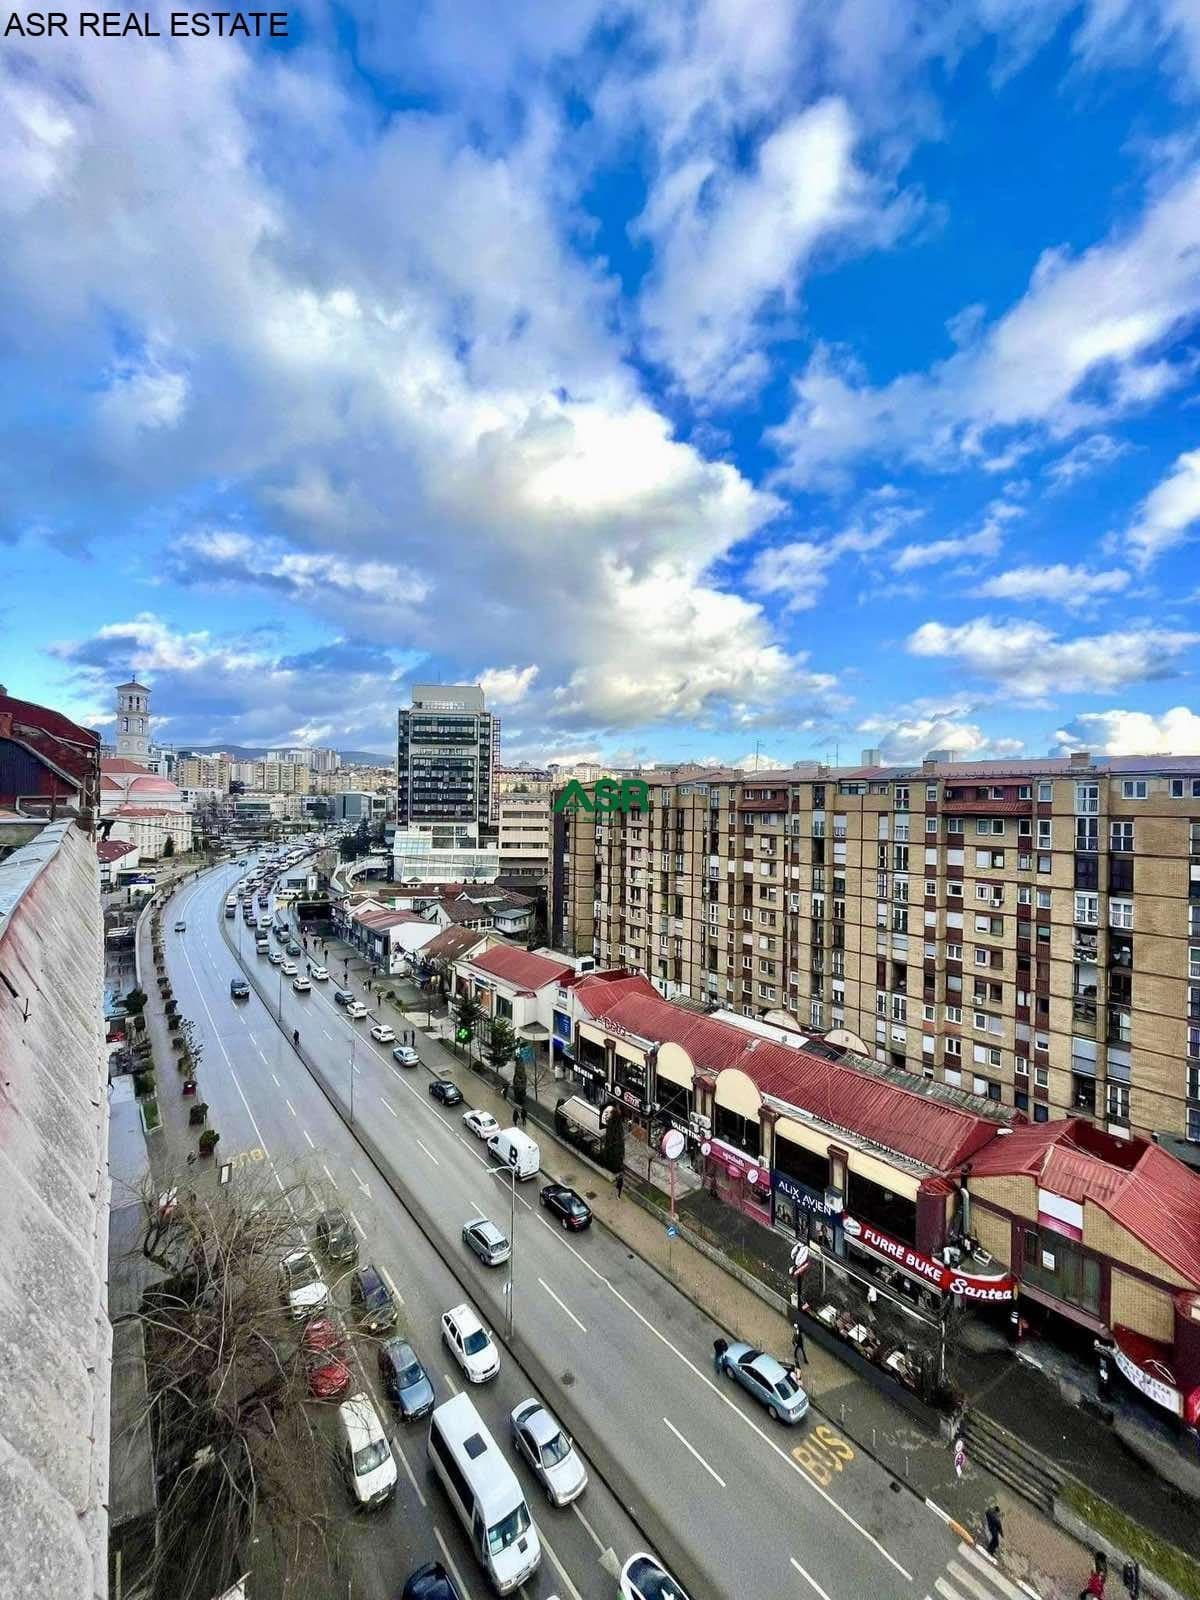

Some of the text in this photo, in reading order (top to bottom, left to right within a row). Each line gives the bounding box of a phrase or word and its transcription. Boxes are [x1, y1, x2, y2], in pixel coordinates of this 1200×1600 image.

[802, 1194, 832, 1216] AVIEN
[864, 1229, 943, 1282] FURRË BUKE
[949, 1278, 1013, 1300] Santea
[791, 1424, 855, 1487] BUS
